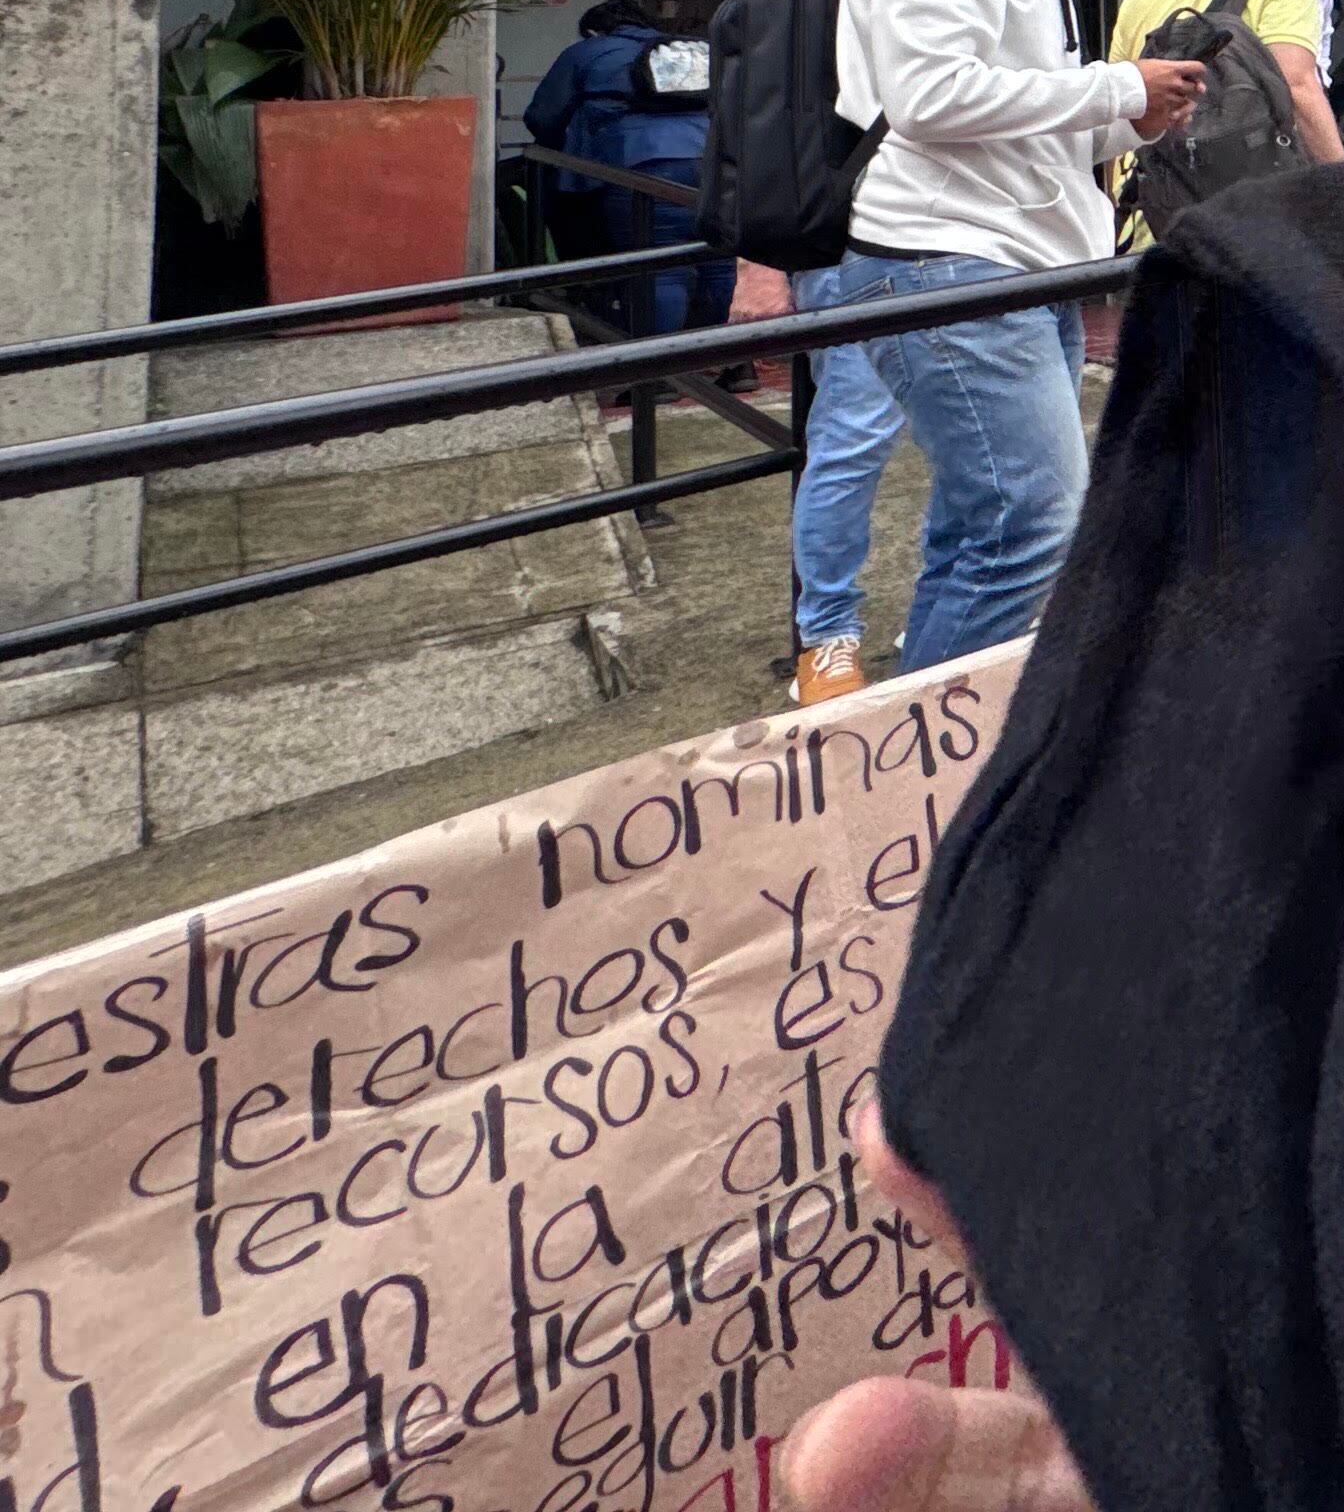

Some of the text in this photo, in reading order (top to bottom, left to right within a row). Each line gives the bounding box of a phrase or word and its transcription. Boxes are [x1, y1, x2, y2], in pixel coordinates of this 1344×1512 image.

[538, 686, 981, 909] nominas
[129, 916, 690, 1212] derechos
[195, 1010, 731, 1317] recursos,
[774, 935, 883, 1051] es
[254, 1273, 430, 1429] en
[508, 1181, 627, 1314] la
